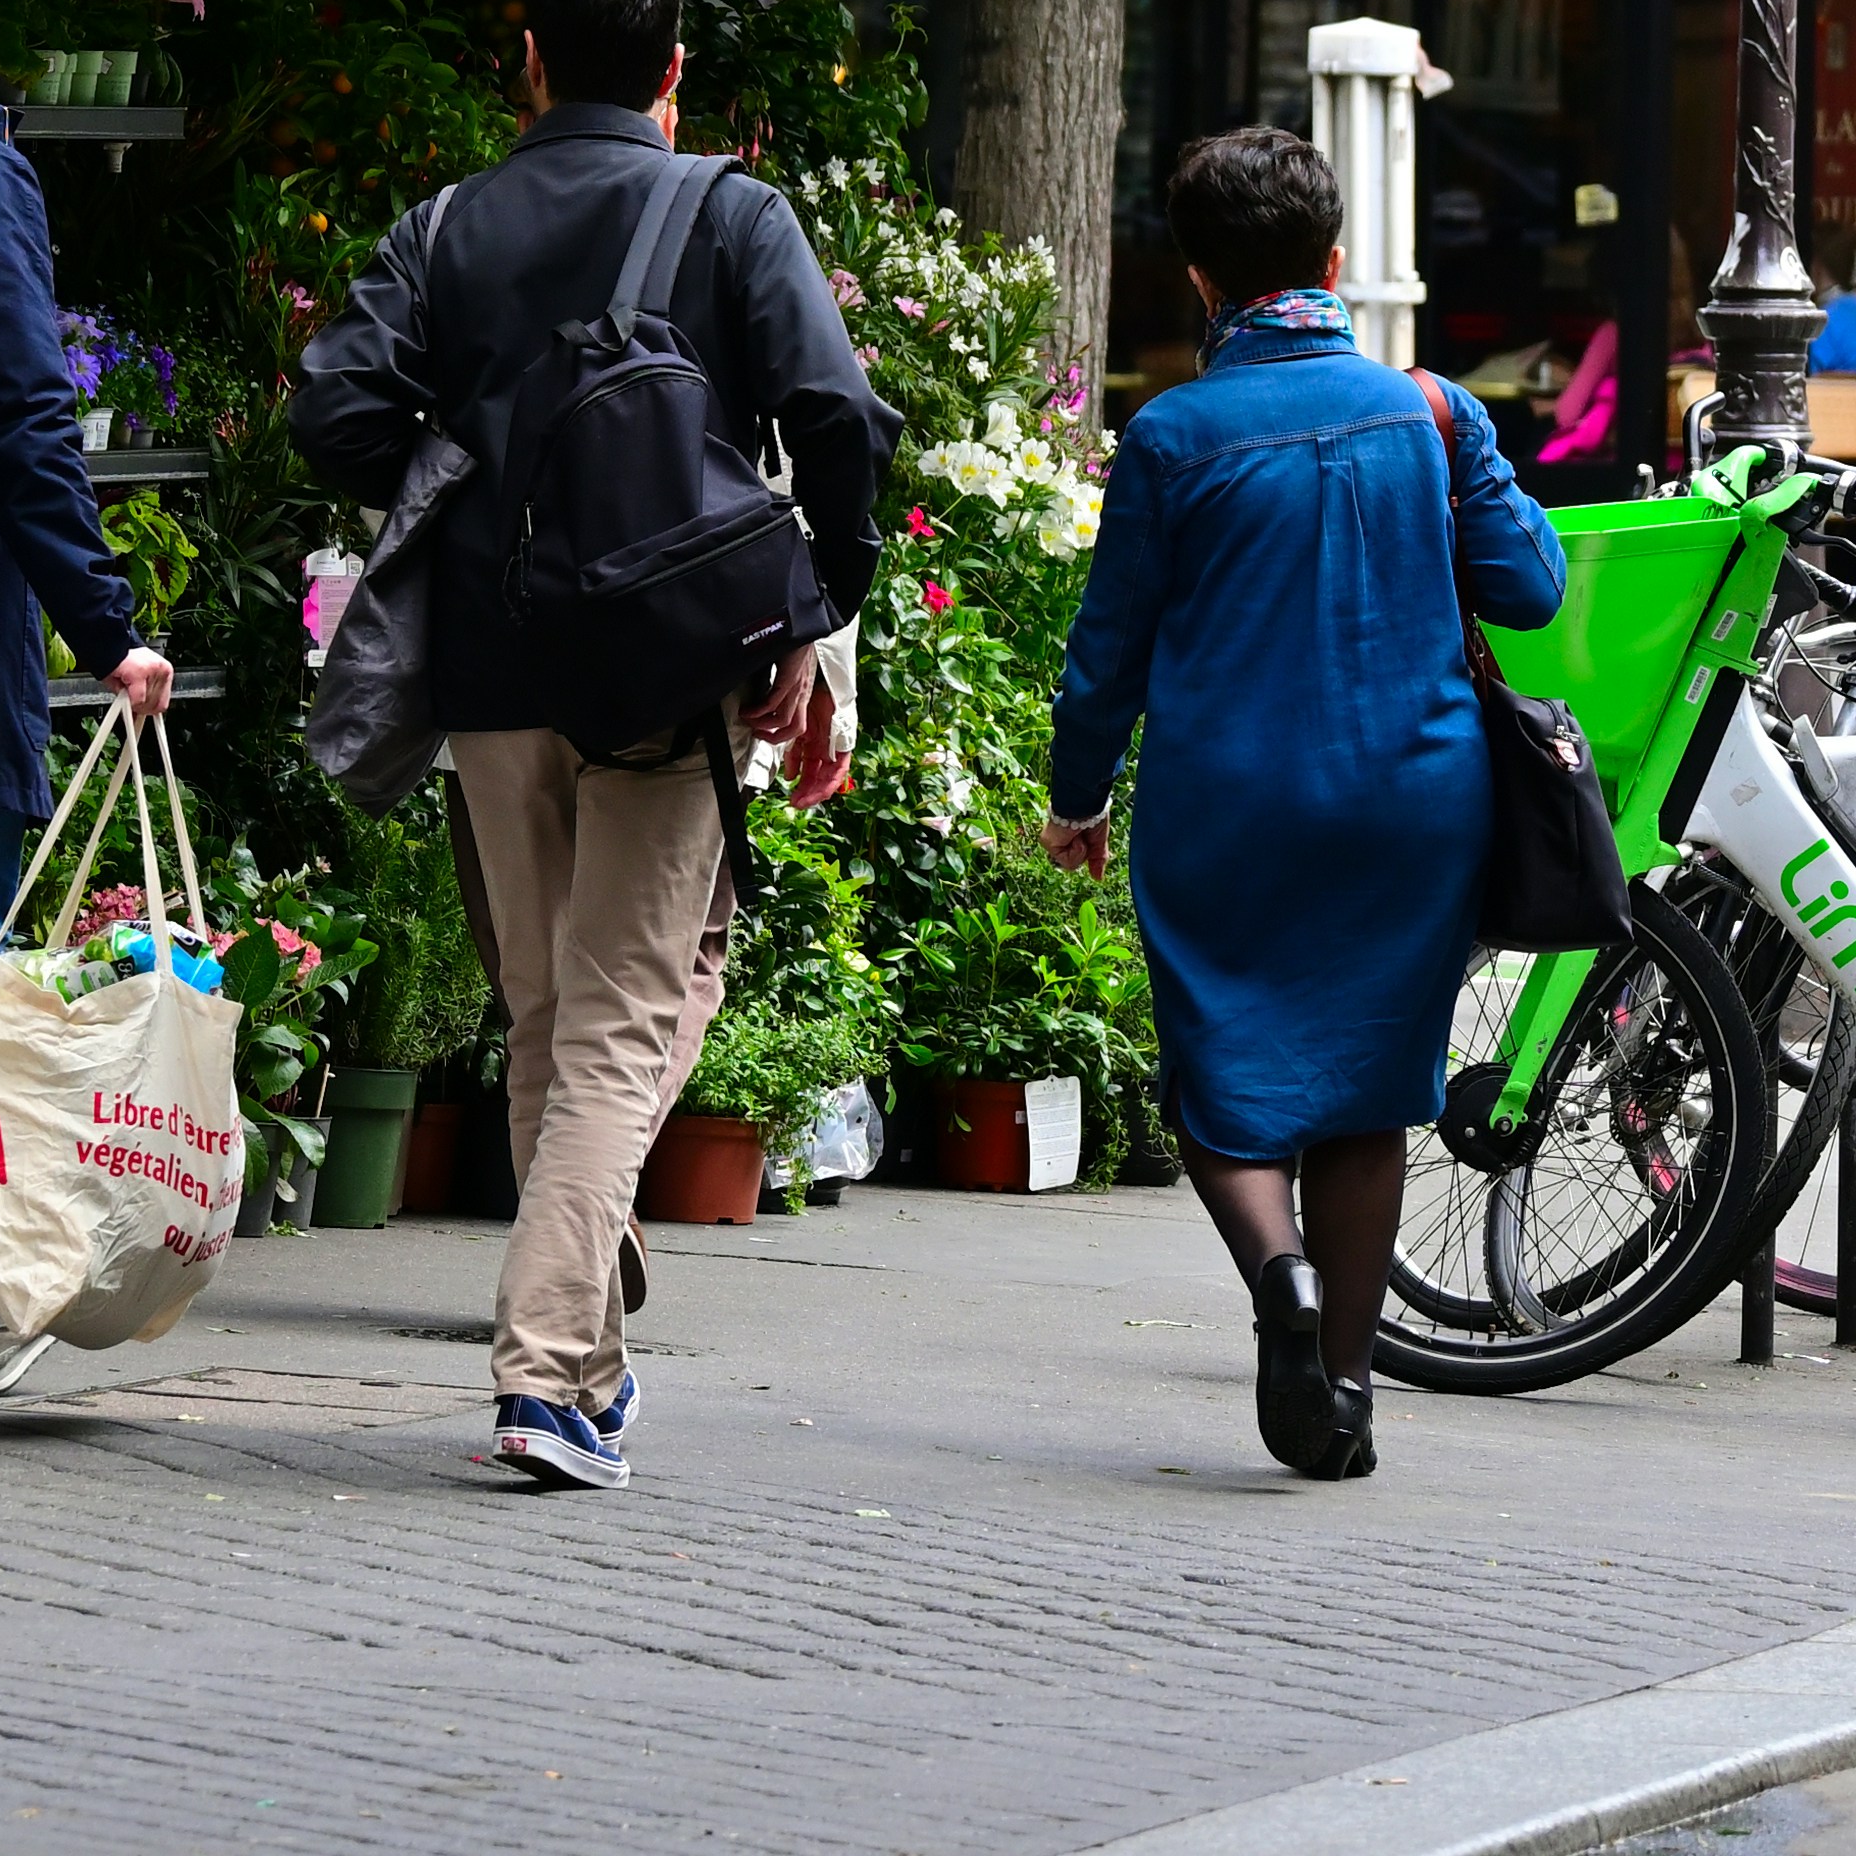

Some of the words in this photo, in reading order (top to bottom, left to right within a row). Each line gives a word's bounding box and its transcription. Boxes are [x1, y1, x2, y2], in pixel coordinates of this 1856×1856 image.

[94, 1091, 164, 1132] Libre
[169, 1103, 230, 1157] d'être
[76, 1135, 214, 1215] végétalien,
[163, 1224, 194, 1258] ou
